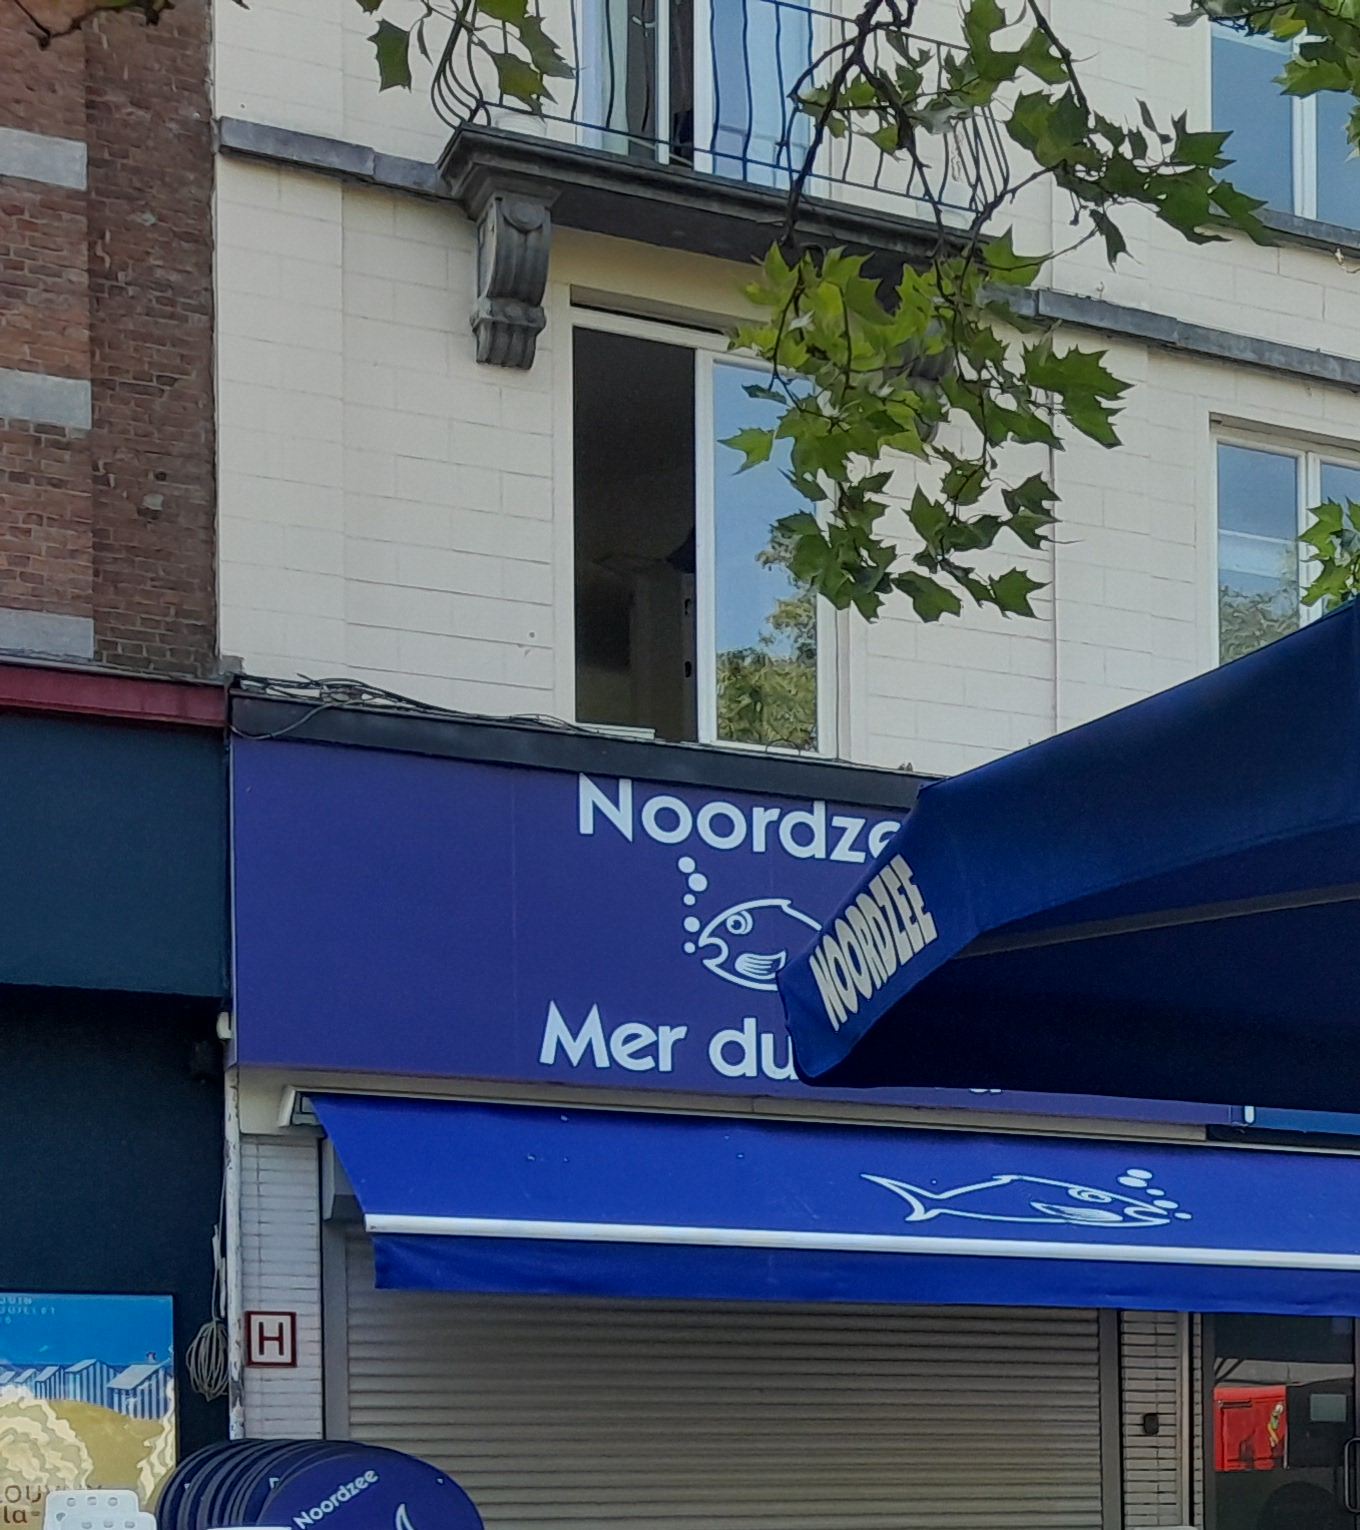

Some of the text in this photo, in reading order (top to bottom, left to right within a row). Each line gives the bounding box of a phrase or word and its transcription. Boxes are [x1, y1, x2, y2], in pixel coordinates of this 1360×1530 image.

[809, 854, 937, 1033] NOORDZEE
[539, 1000, 799, 1080] Mer du
[258, 1321, 284, 1356] H
[293, 1470, 378, 1530] Noordzee
